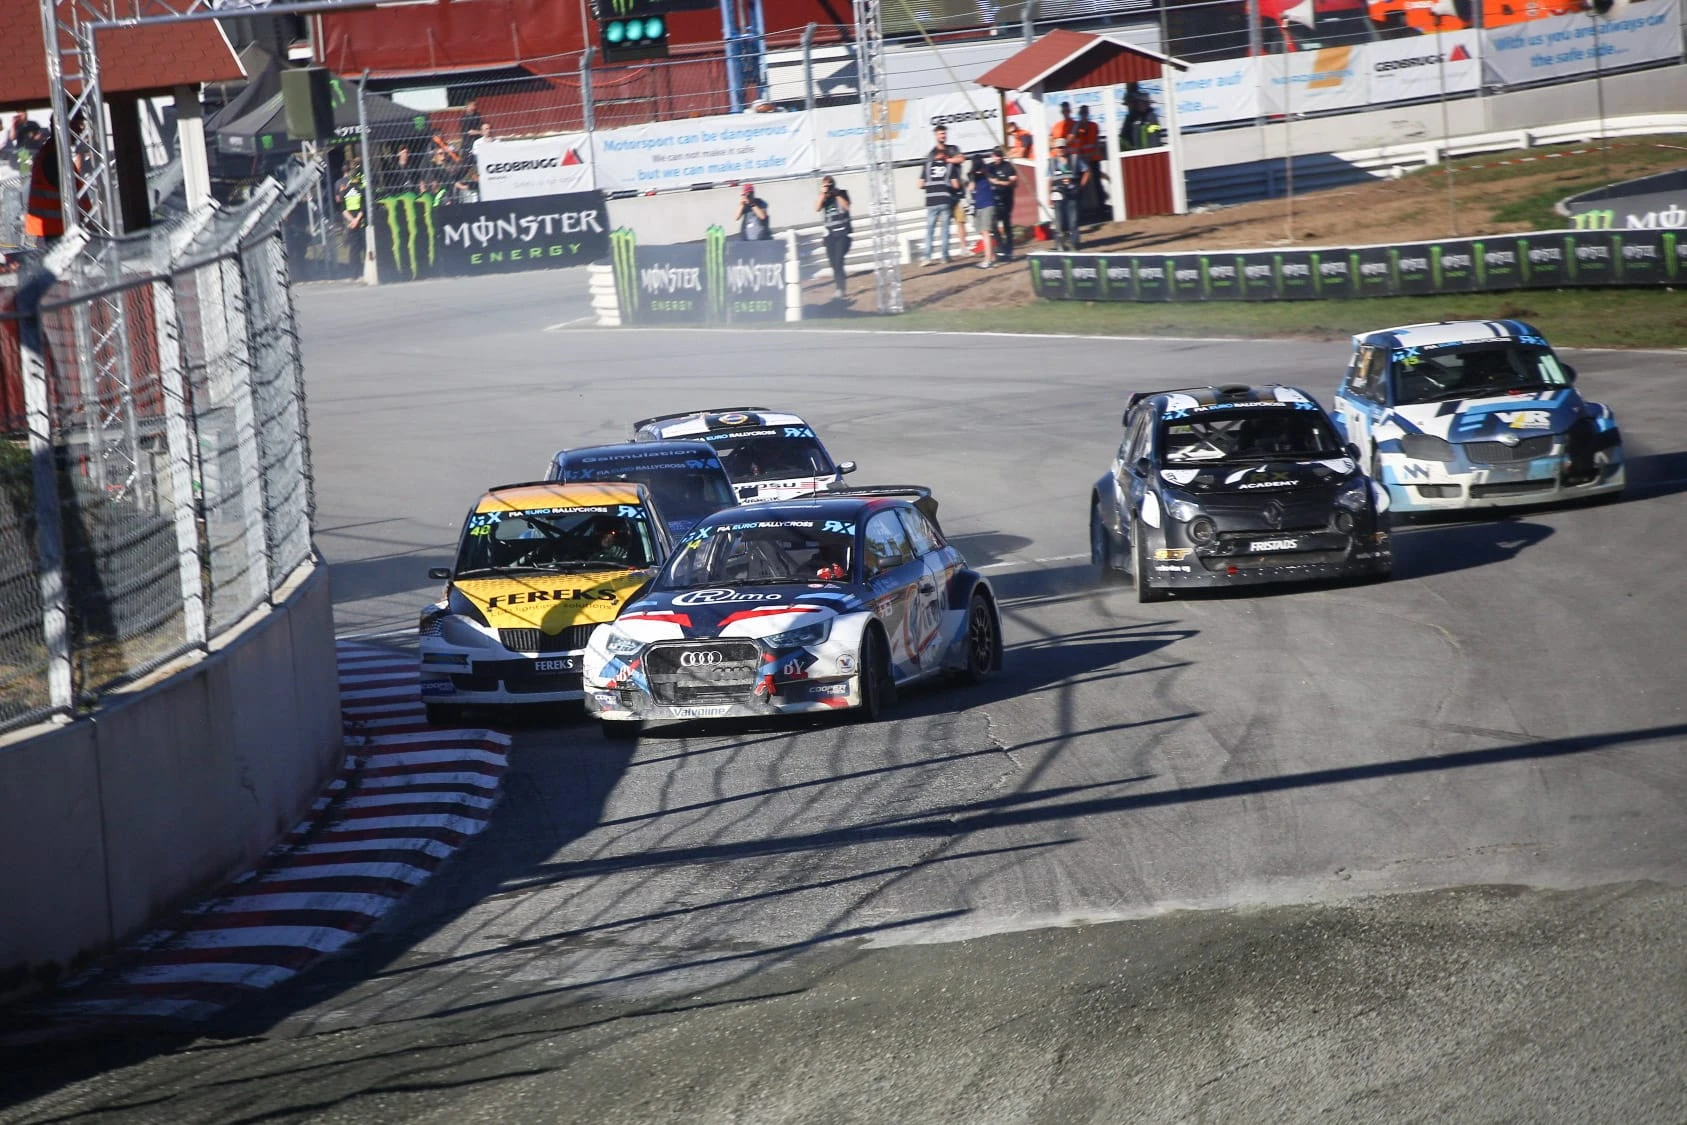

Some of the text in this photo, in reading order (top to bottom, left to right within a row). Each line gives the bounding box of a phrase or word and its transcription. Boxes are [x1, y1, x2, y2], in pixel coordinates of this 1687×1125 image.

[1493, 35, 1525, 50] With
[1528, 34, 1544, 46] us
[1545, 31, 1570, 46] you
[1599, 16, 1645, 33] always
[1530, 53, 1553, 67] the
[1556, 48, 1584, 62] safe
[604, 135, 673, 151] Motorsport
[677, 133, 699, 145] can
[701, 130, 718, 142] be
[667, 153, 683, 162] can
[684, 151, 700, 160] not
[702, 148, 727, 159] make
[737, 145, 756, 154] safe
[485, 159, 559, 175] GEOBRUGG
[663, 166, 681, 178] we
[683, 164, 705, 176] can
[708, 159, 741, 174] make
[745, 158, 754, 168] it
[755, 156, 786, 168] safer
[443, 209, 604, 249] MONSTER
[470, 243, 582, 265] ENERGY
[651, 300, 694, 312] ENERGY
[734, 300, 774, 312] ENERGY
[729, 430, 777, 438] RALLYCROSS
[635, 462, 686, 471] RALLYCROSS
[1239, 480, 1300, 490] ACADEMY
[552, 507, 608, 515] RALLYCROSS
[717, 525, 731, 533] FIA
[732, 522, 758, 531] EURO
[758, 520, 814, 529] RALLYCROSS
[1250, 539, 1299, 552] FRISTADS
[488, 588, 618, 610] FEREKS
[563, 602, 613, 611] solutions
[535, 658, 574, 671] FEREKS
[809, 684, 847, 693] COOPER
[674, 706, 726, 717] Valvoline
